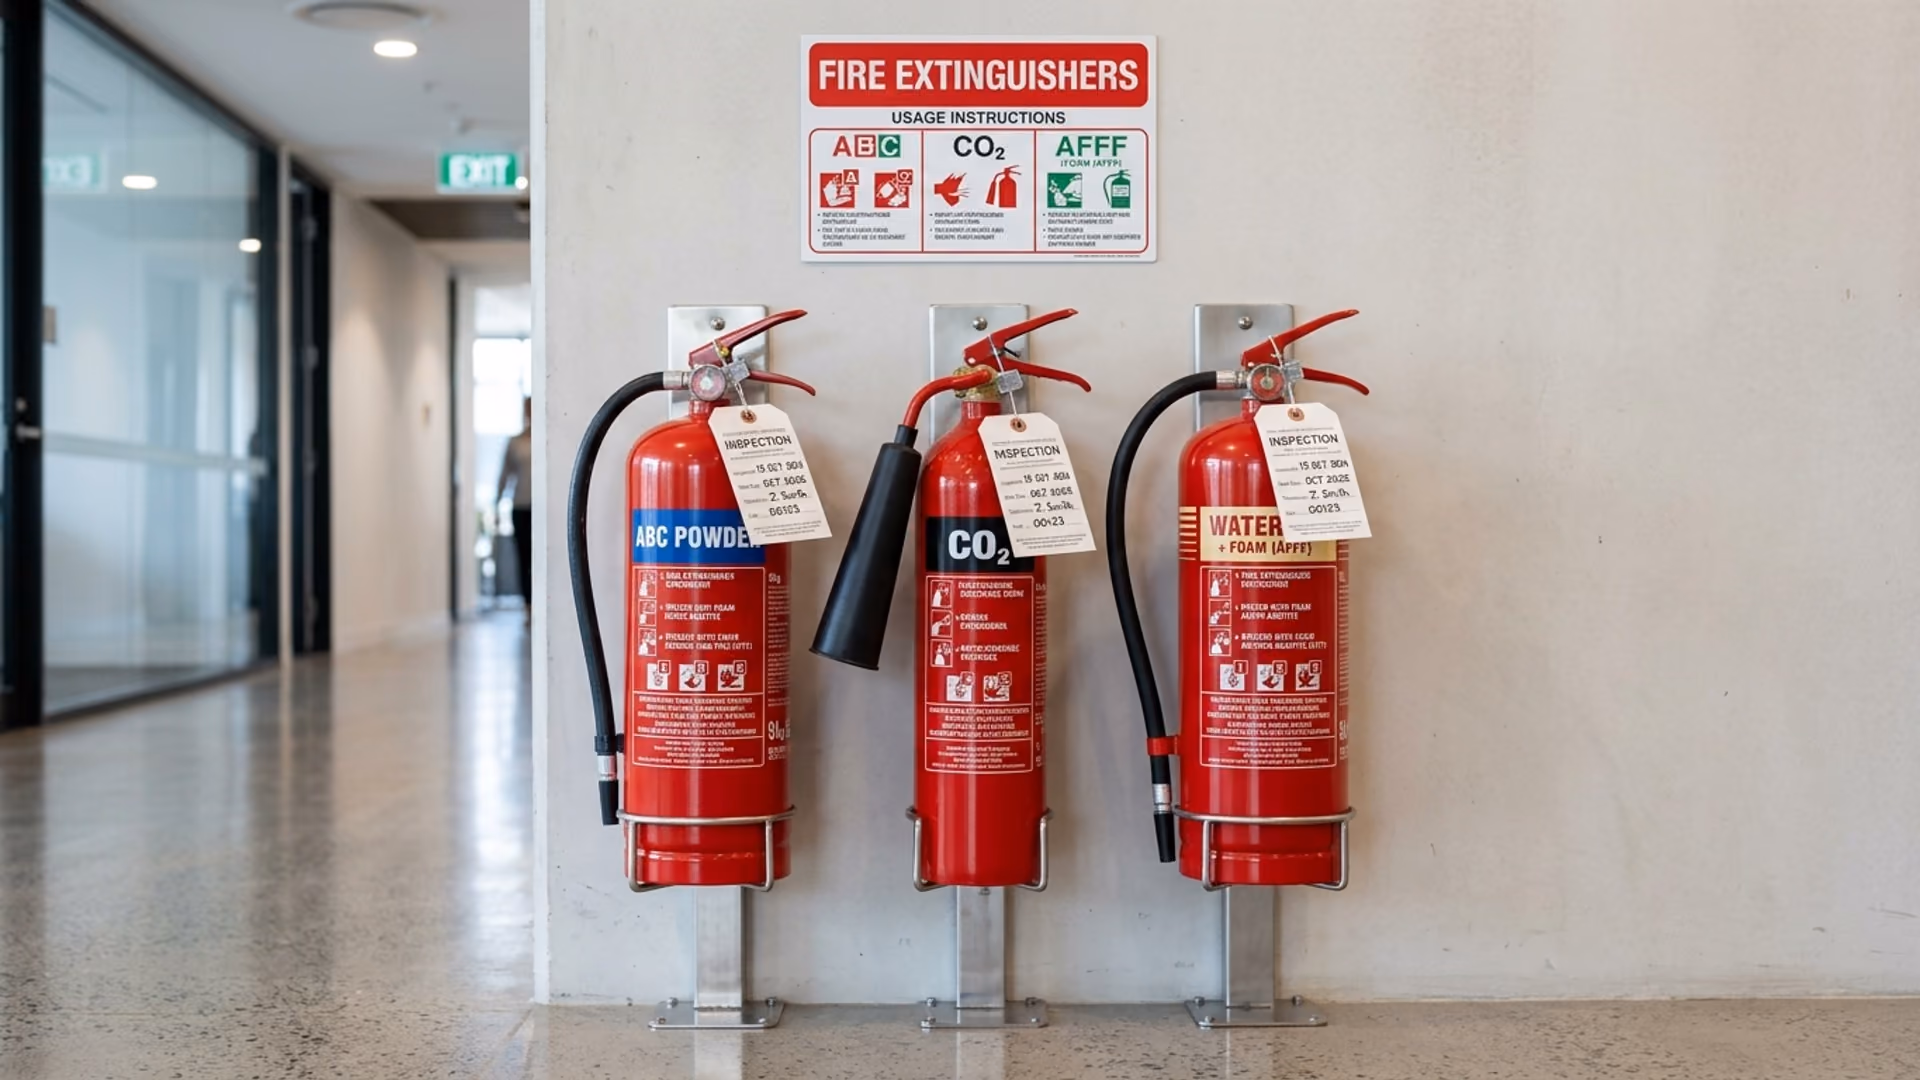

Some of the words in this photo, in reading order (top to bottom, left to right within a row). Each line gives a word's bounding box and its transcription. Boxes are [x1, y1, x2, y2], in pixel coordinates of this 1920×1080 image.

[818, 59, 886, 90] FIRE
[896, 59, 1139, 91] EXTINGUISHERS
[891, 111, 946, 125] USAGE
[950, 111, 1066, 125] INSTRUCTIONS
[832, 135, 900, 157] ABC
[1055, 135, 1128, 157] AFFF
[449, 154, 509, 188] EXIT
[1268, 433, 1339, 447] INSPECTION
[1209, 515, 1283, 537] WATER
[635, 526, 668, 549] ABC
[674, 526, 761, 549] POWDE
[1229, 541, 1267, 554] FOAM
